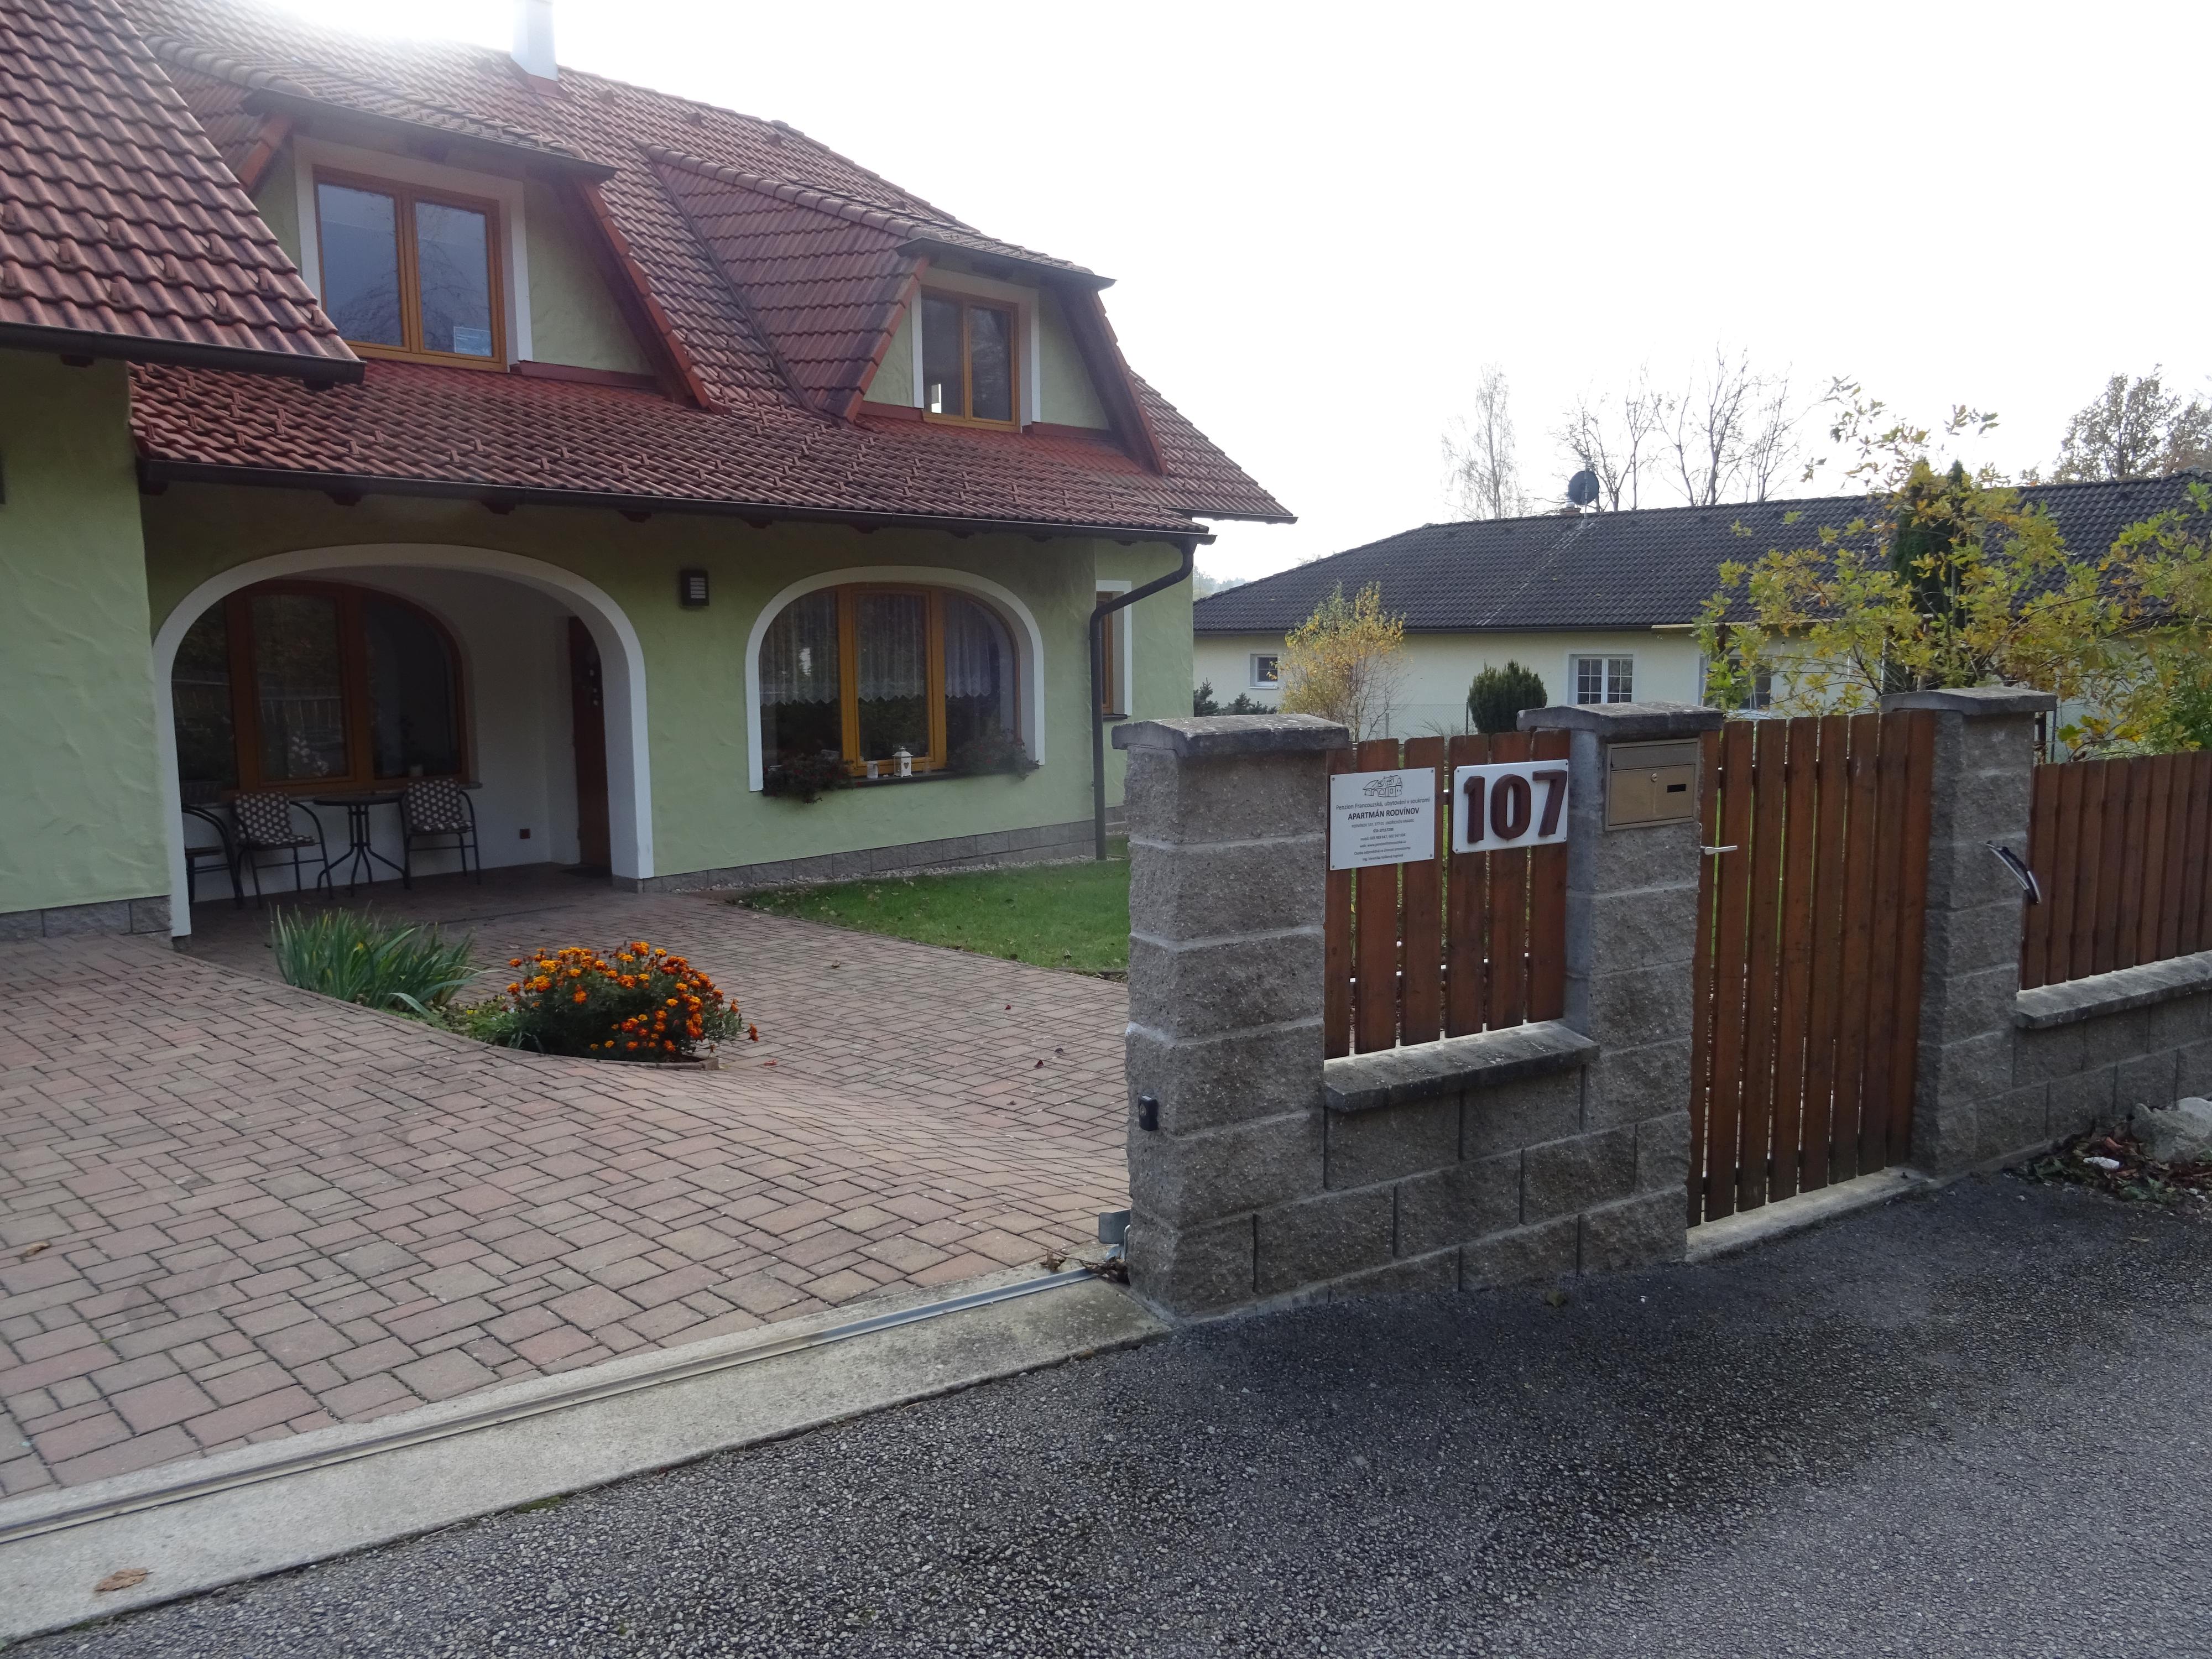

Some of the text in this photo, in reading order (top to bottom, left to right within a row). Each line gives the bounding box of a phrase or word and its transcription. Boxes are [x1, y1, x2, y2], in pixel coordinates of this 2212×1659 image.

[1348, 807, 1420, 820] APARTMÁN RODVÍNOV
[1463, 769, 1567, 844] 107
